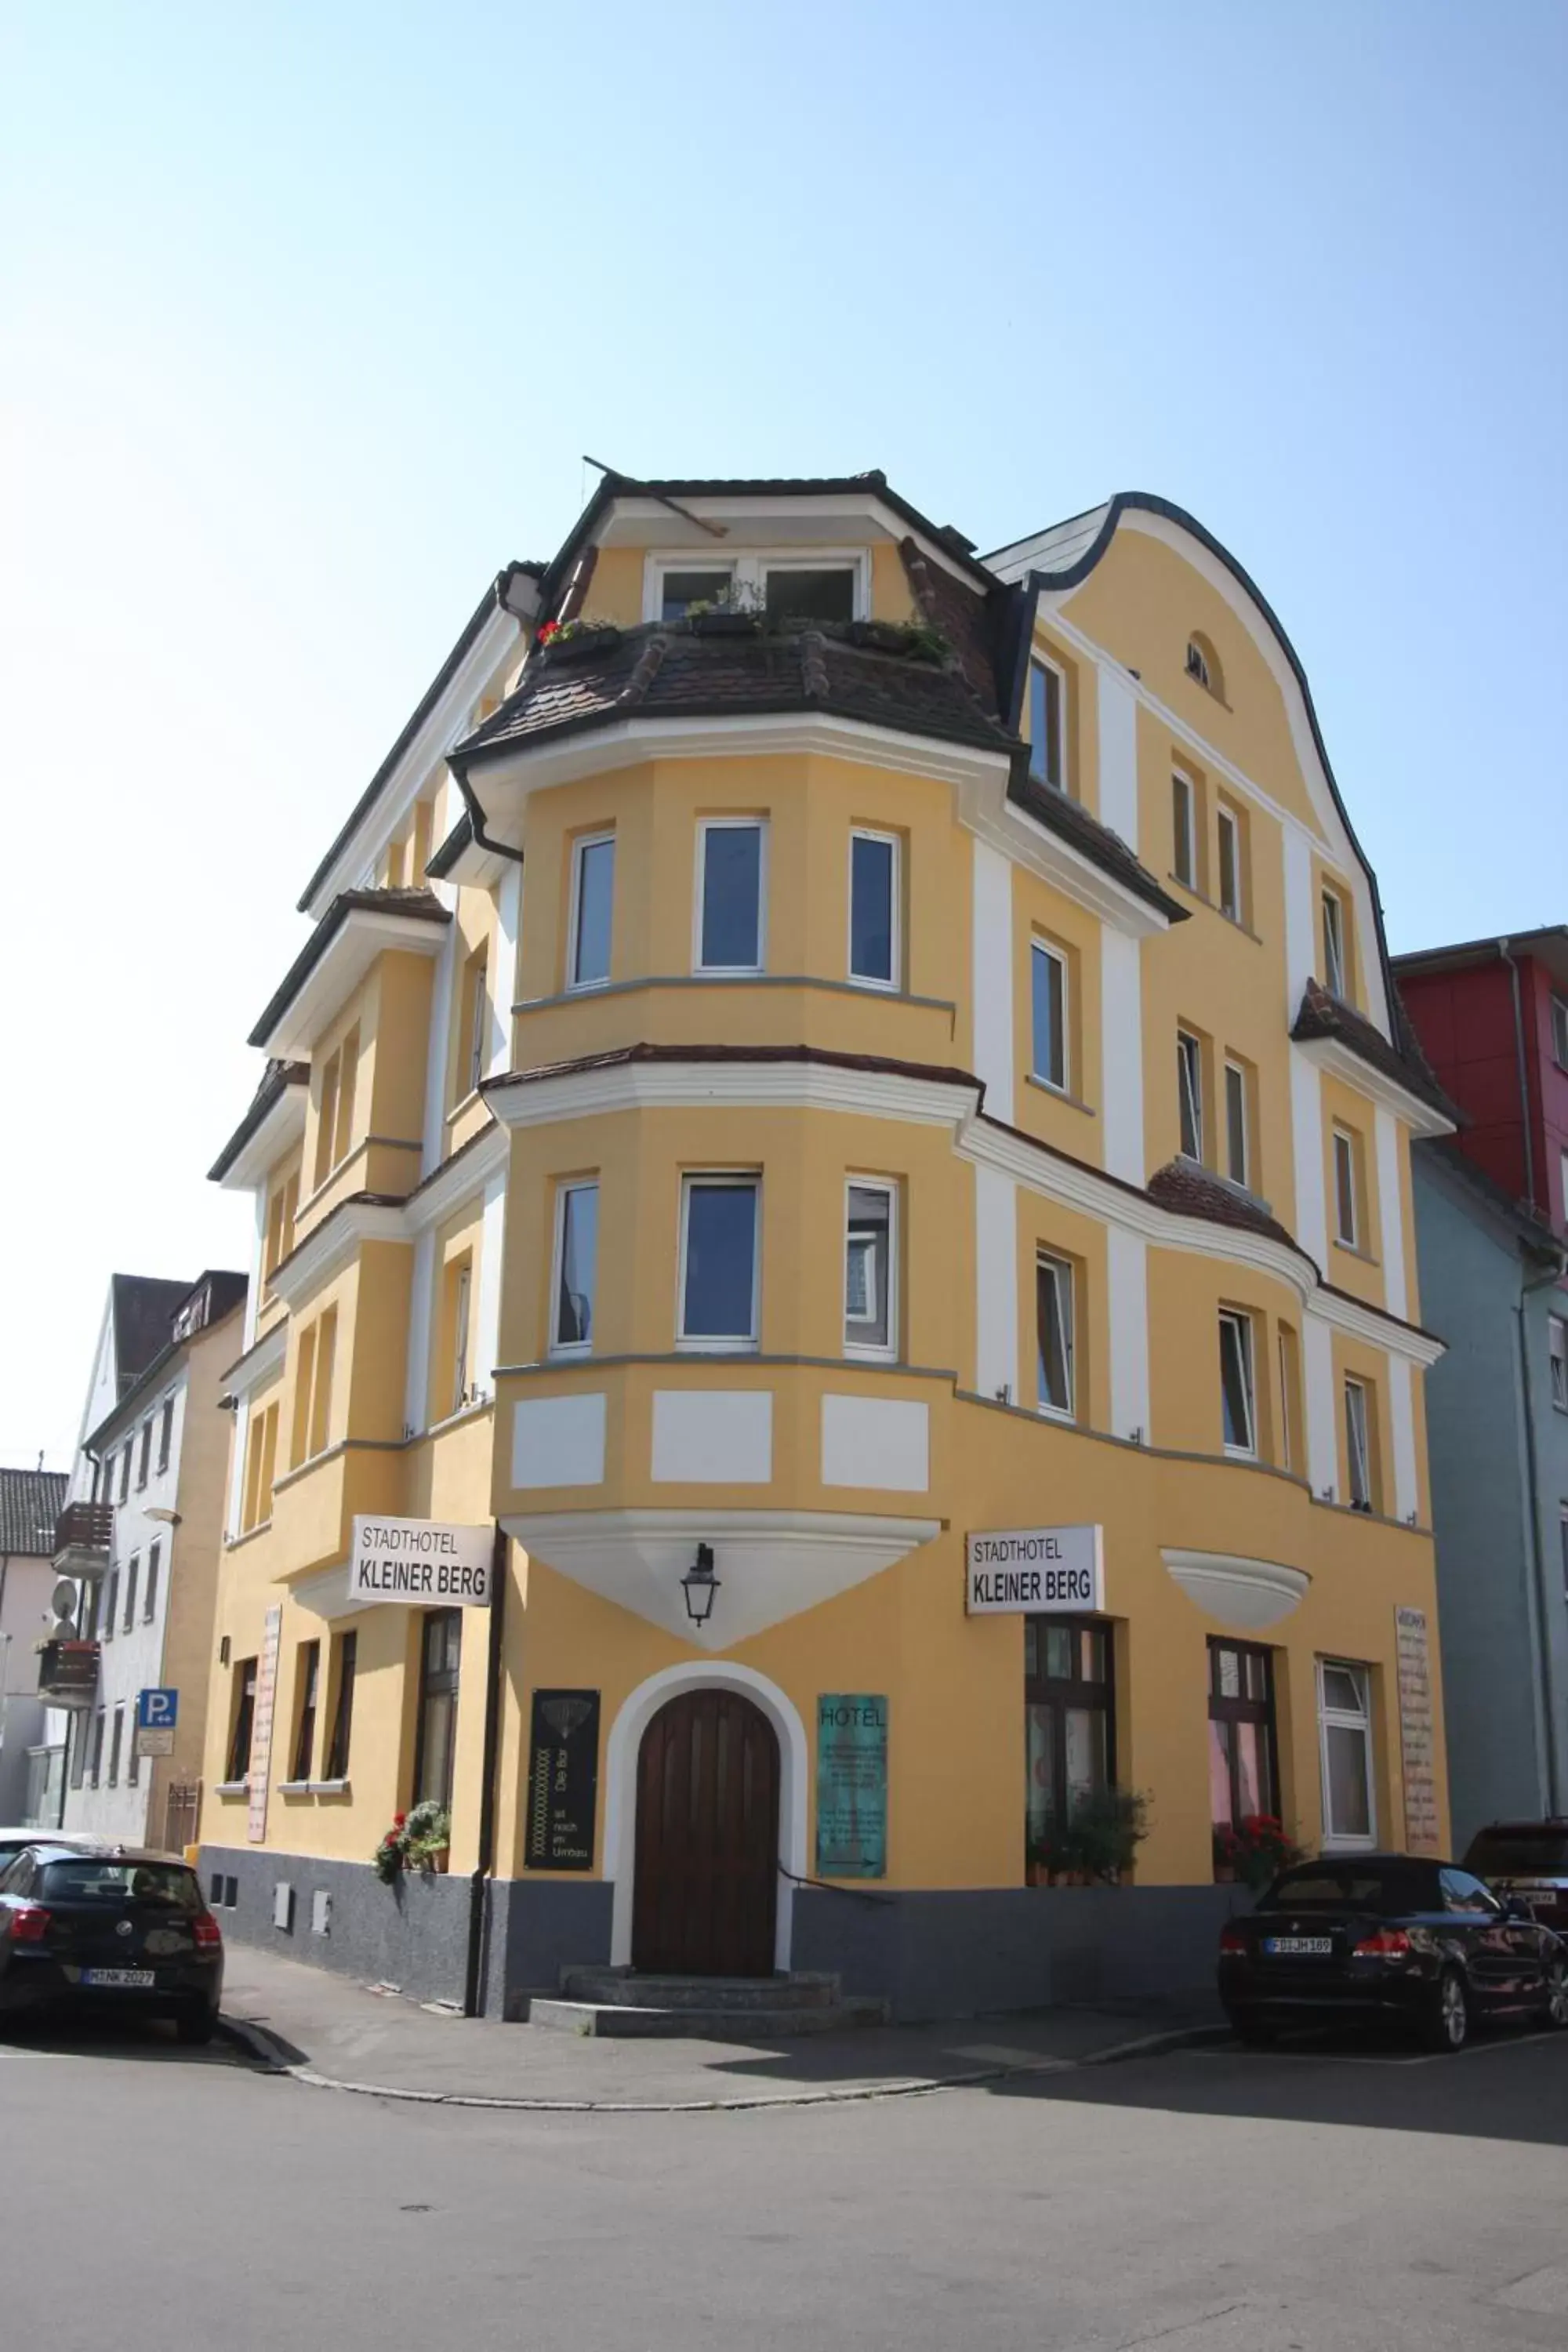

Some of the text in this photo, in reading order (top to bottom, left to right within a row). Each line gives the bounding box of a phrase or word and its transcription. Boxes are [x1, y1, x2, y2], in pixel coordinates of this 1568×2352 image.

[362, 1526, 458, 1555] STADTHOTEL
[974, 1538, 1062, 1563] STADTHOTEL
[359, 1559, 485, 1596] KLEINER BERG
[974, 1568, 1091, 1603] KLEINER BERG
[147, 1693, 169, 1723] P
[821, 1707, 886, 1727] HOTEL
[553, 1847, 588, 1858] Umbau
